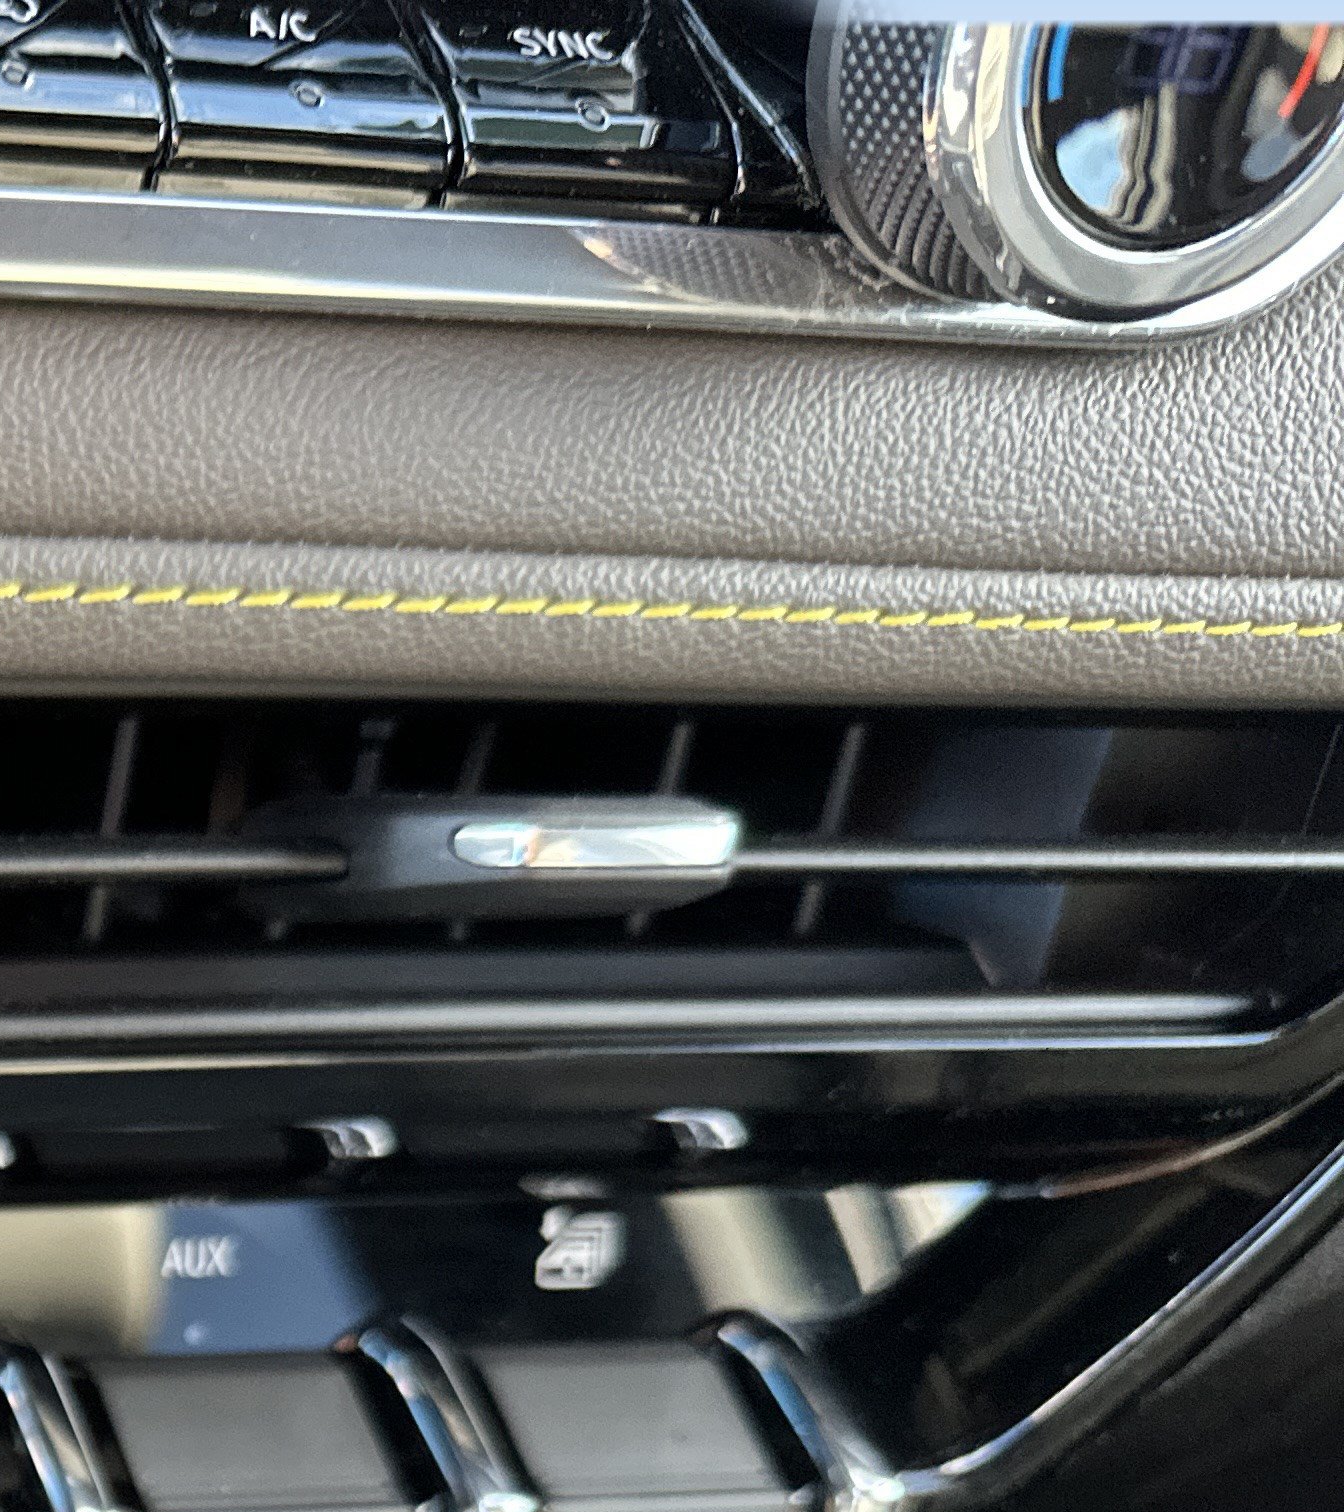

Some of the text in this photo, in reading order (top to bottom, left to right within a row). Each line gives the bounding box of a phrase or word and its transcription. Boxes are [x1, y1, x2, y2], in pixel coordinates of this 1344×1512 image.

[248, 9, 316, 42] A/C
[513, 26, 614, 60] SYNC
[161, 1235, 232, 1278] AUX
